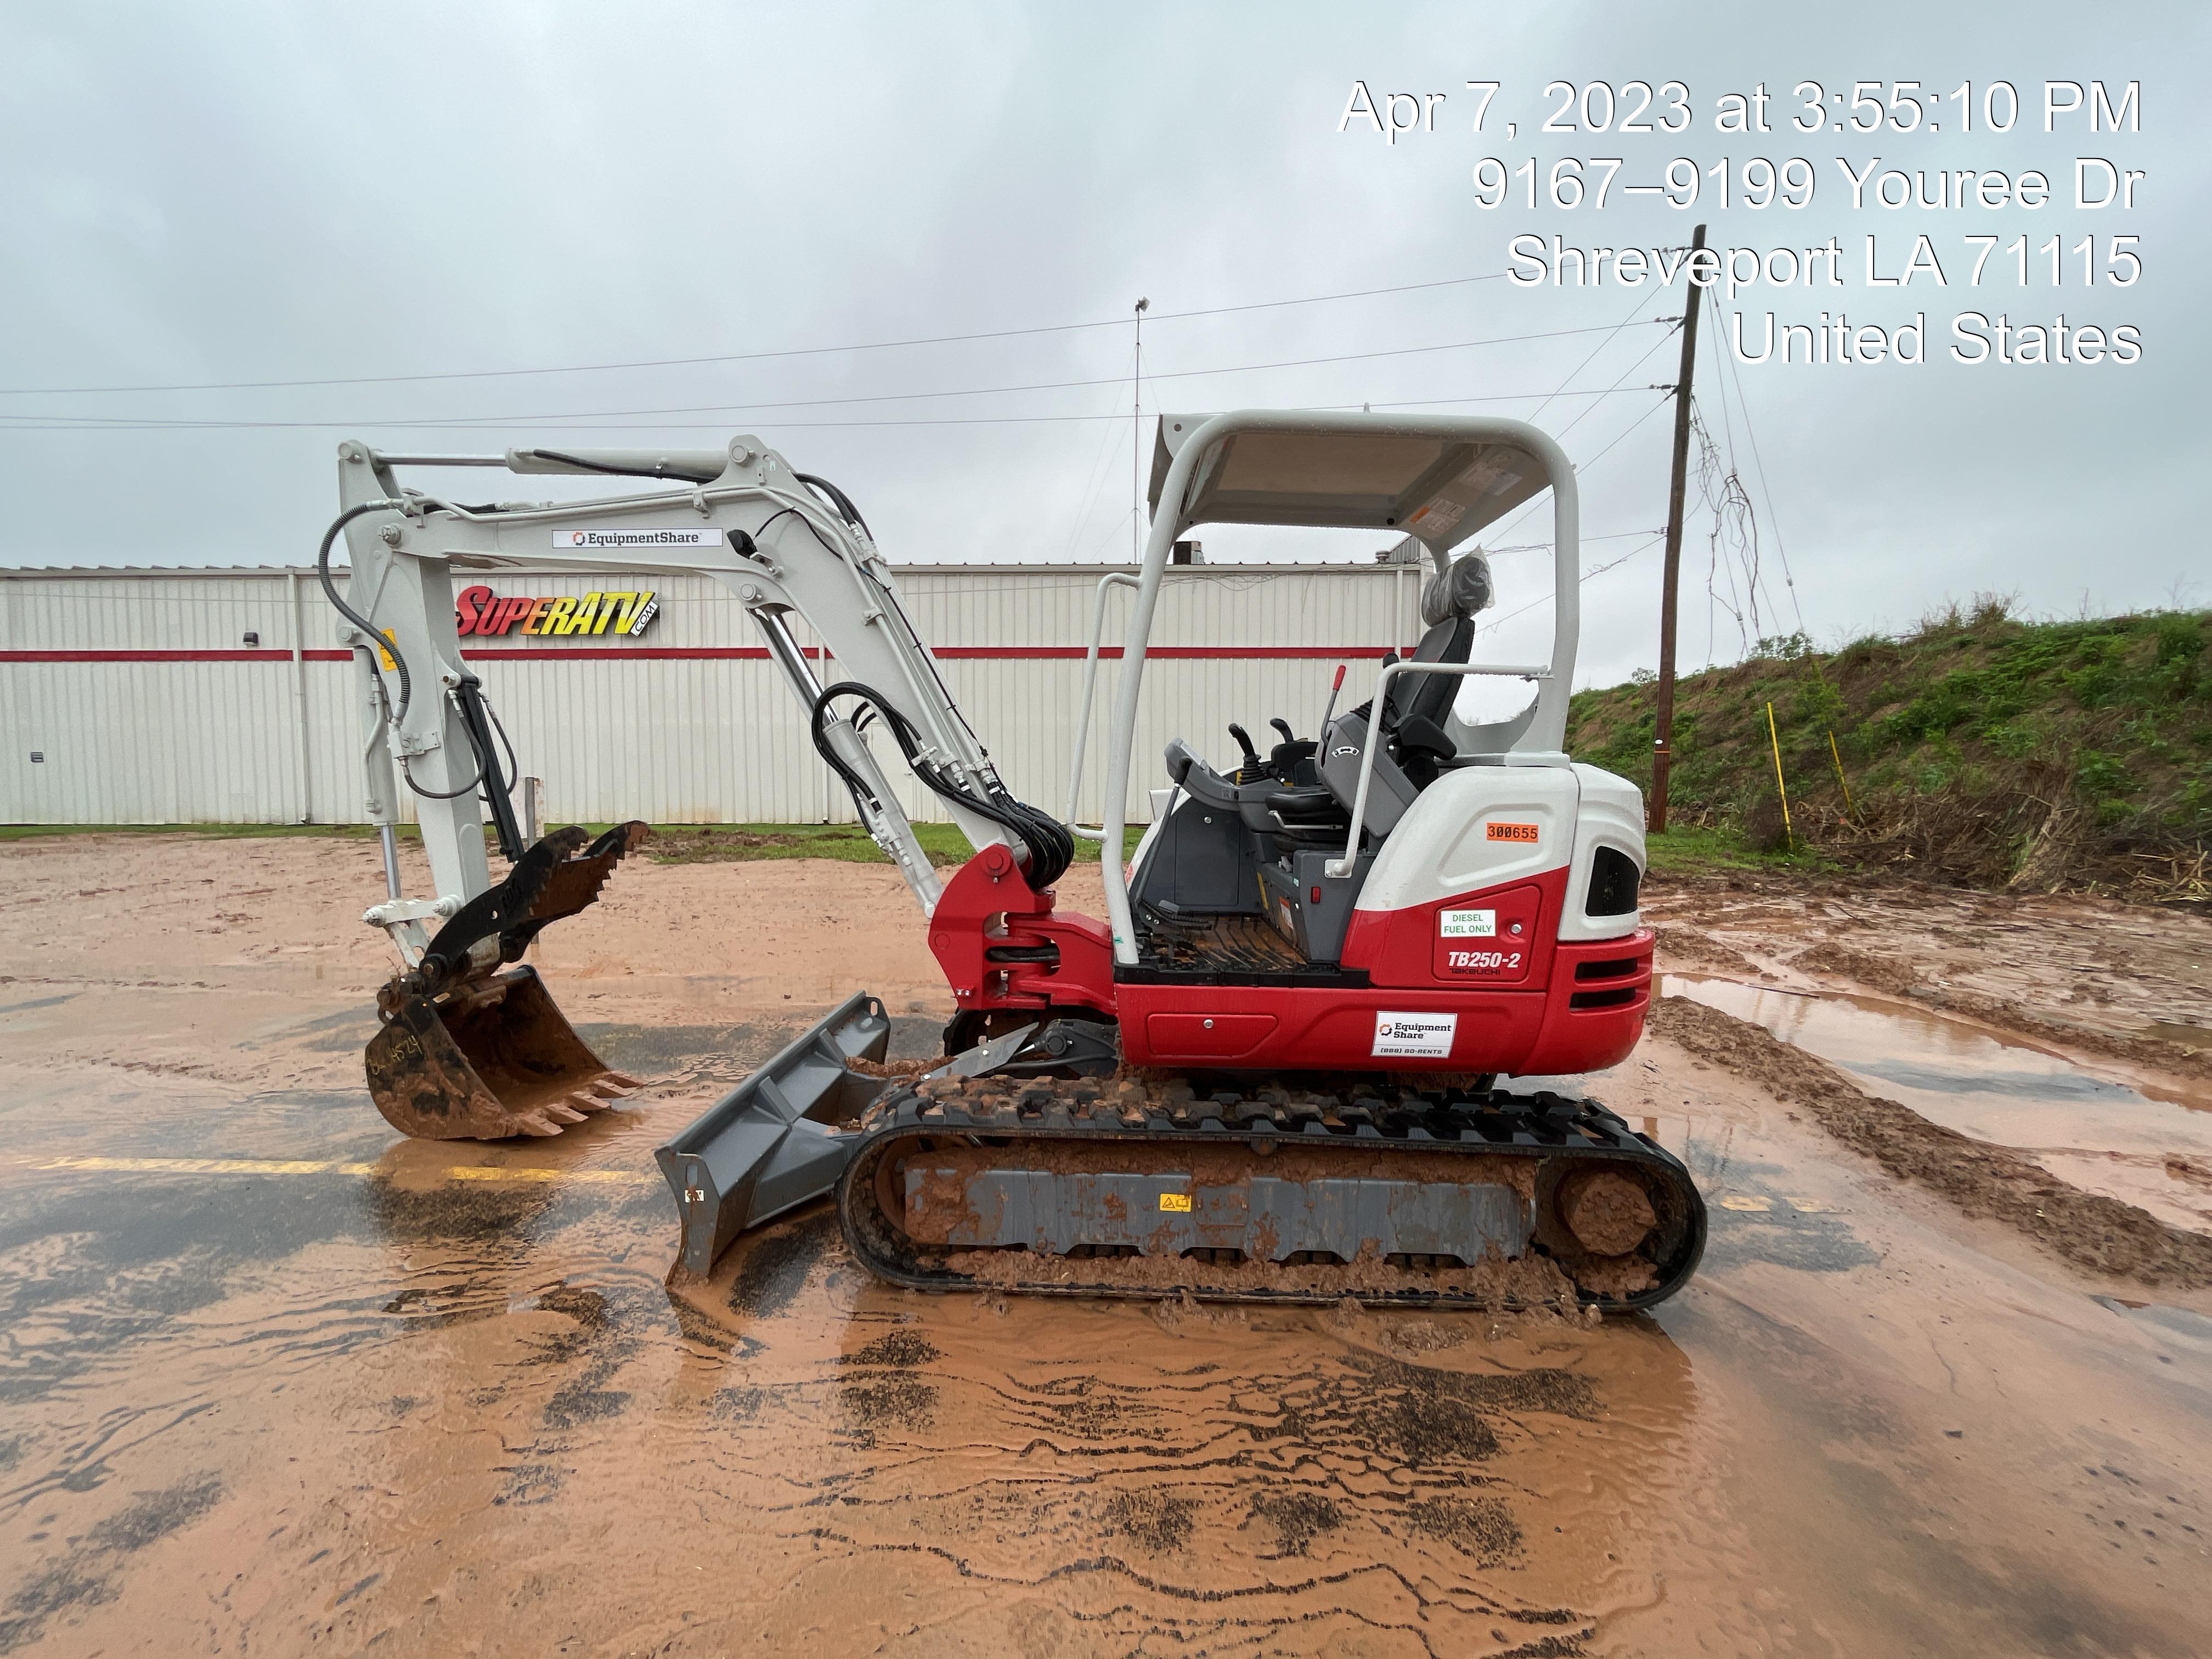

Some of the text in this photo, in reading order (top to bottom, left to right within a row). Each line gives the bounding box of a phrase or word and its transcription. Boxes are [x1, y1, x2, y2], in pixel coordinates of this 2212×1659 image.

[588, 532, 699, 546] EquipmentShare
[1488, 826, 1538, 839] 300655
[1448, 951, 1521, 968] TB250-2
[1395, 1023, 1452, 1032] Equipment
